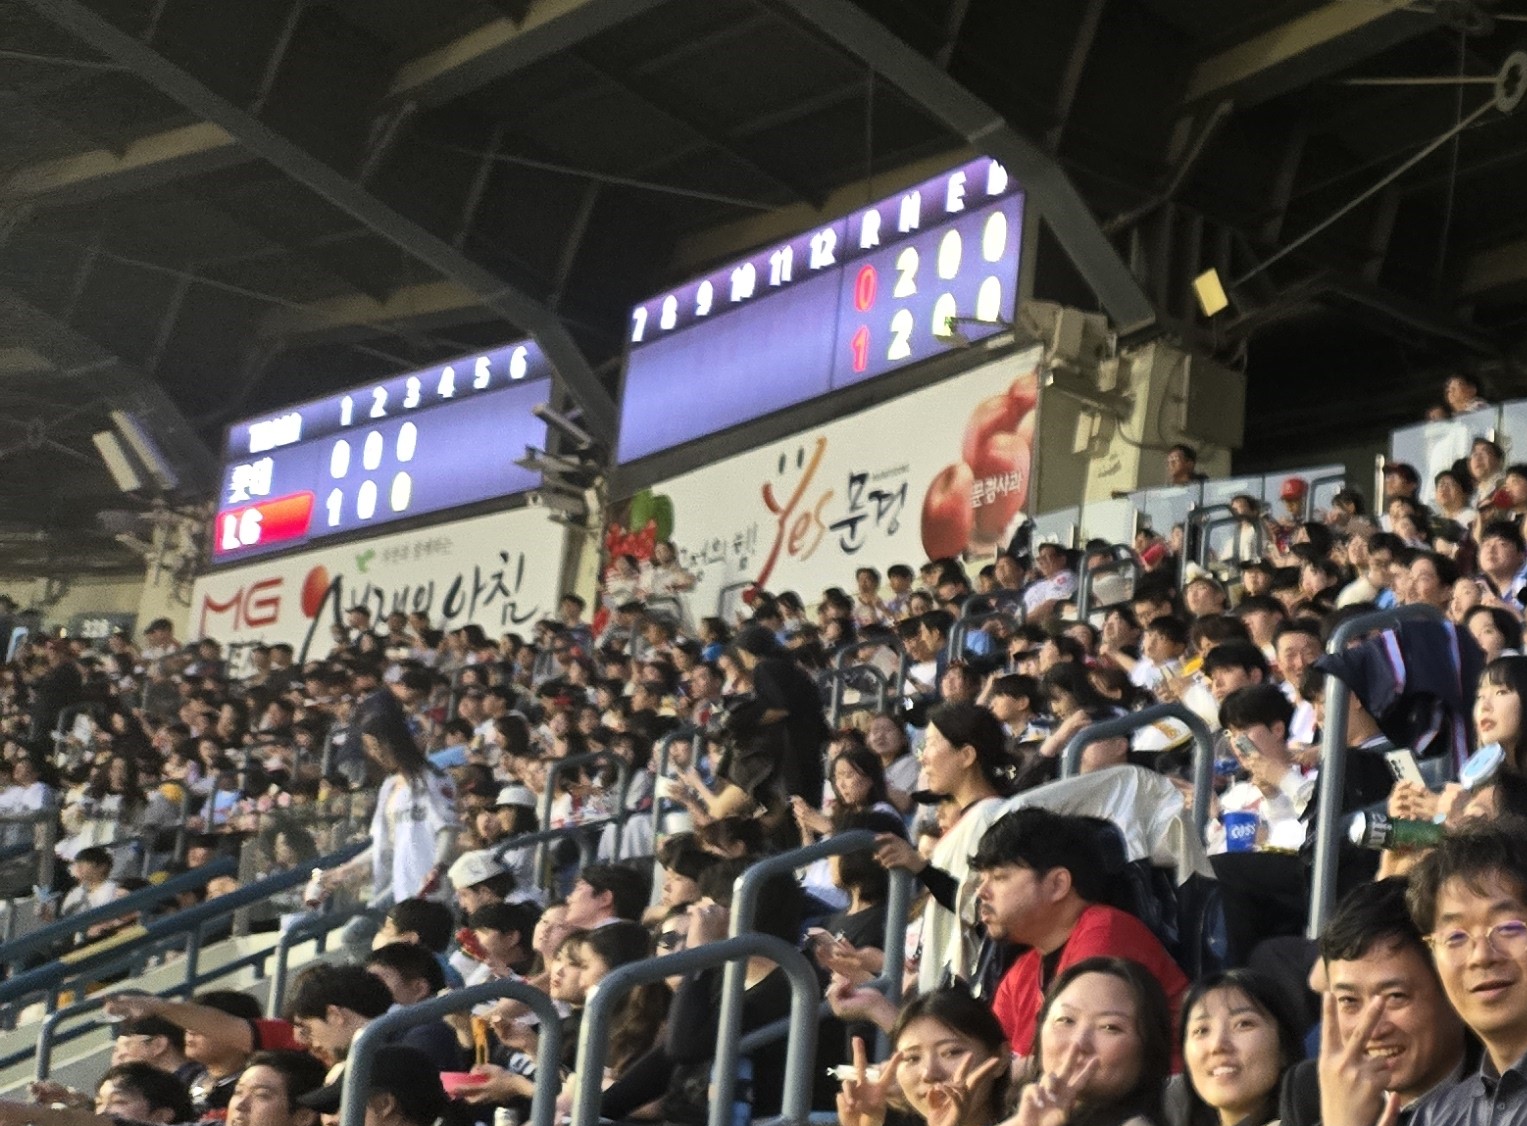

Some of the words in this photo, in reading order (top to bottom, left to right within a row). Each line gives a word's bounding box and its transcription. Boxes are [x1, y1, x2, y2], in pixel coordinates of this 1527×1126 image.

[660, 294, 678, 330] 8
[695, 280, 714, 316] 9
[769, 245, 794, 286] 11
[809, 227, 837, 270] 12
[860, 209, 881, 249] R
[946, 171, 967, 213] E
[853, 264, 878, 312] 0
[893, 246, 920, 298] 2
[937, 229, 963, 280] 0
[982, 211, 1007, 263] 0
[850, 326, 870, 373] 1
[887, 308, 914, 361] 2
[976, 275, 1002, 323] 0
[340, 395, 354, 427] 1
[370, 385, 388, 418] 2
[403, 376, 421, 408] 3
[437, 366, 455, 398] 4
[473, 356, 492, 389] 5
[509, 345, 528, 379] 6
[330, 439, 351, 479] 0
[363, 430, 384, 470] 0
[396, 422, 418, 462] 0
[326, 487, 344, 527] 1
[357, 479, 378, 520] 0
[390, 471, 412, 512] 0
[200, 575, 285, 637] MG
